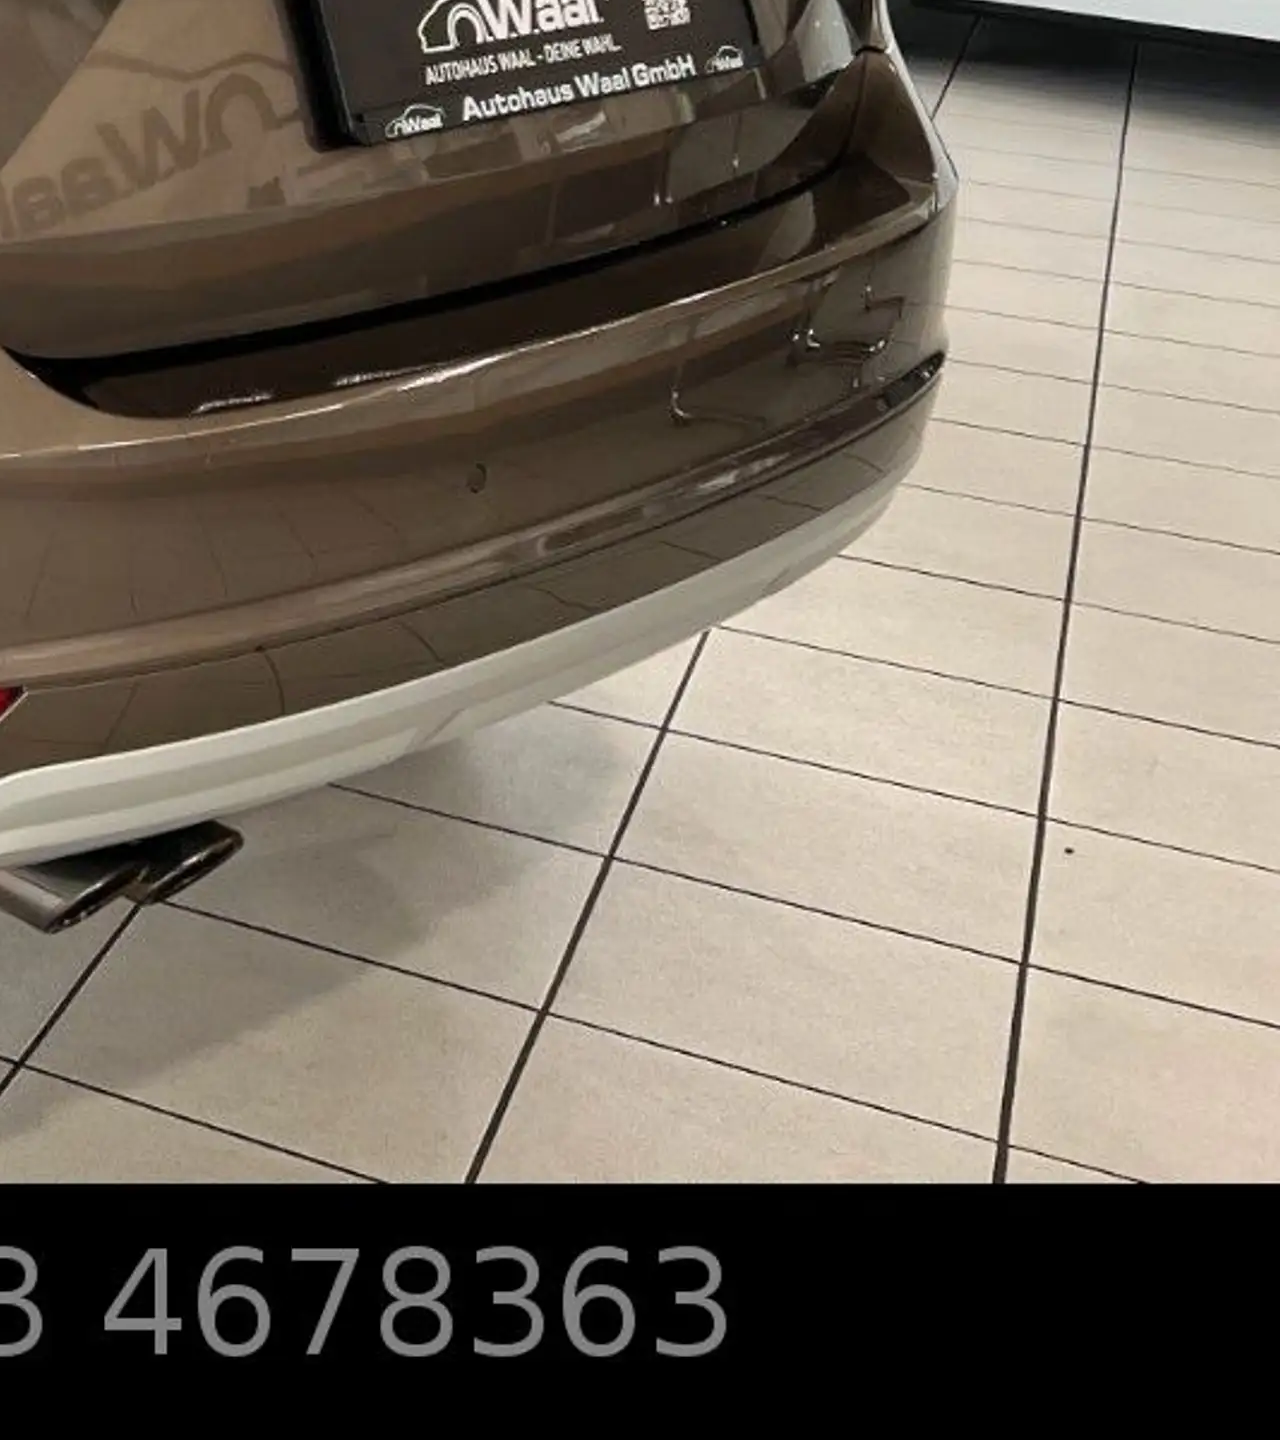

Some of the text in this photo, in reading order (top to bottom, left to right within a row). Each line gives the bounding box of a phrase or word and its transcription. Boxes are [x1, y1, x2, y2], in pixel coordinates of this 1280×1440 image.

[425, 54, 499, 86] AUTOHAUS
[497, 47, 537, 71] WAAL
[543, 38, 583, 64] DEINE
[462, 54, 697, 122] Autohaus Waal GmbH
